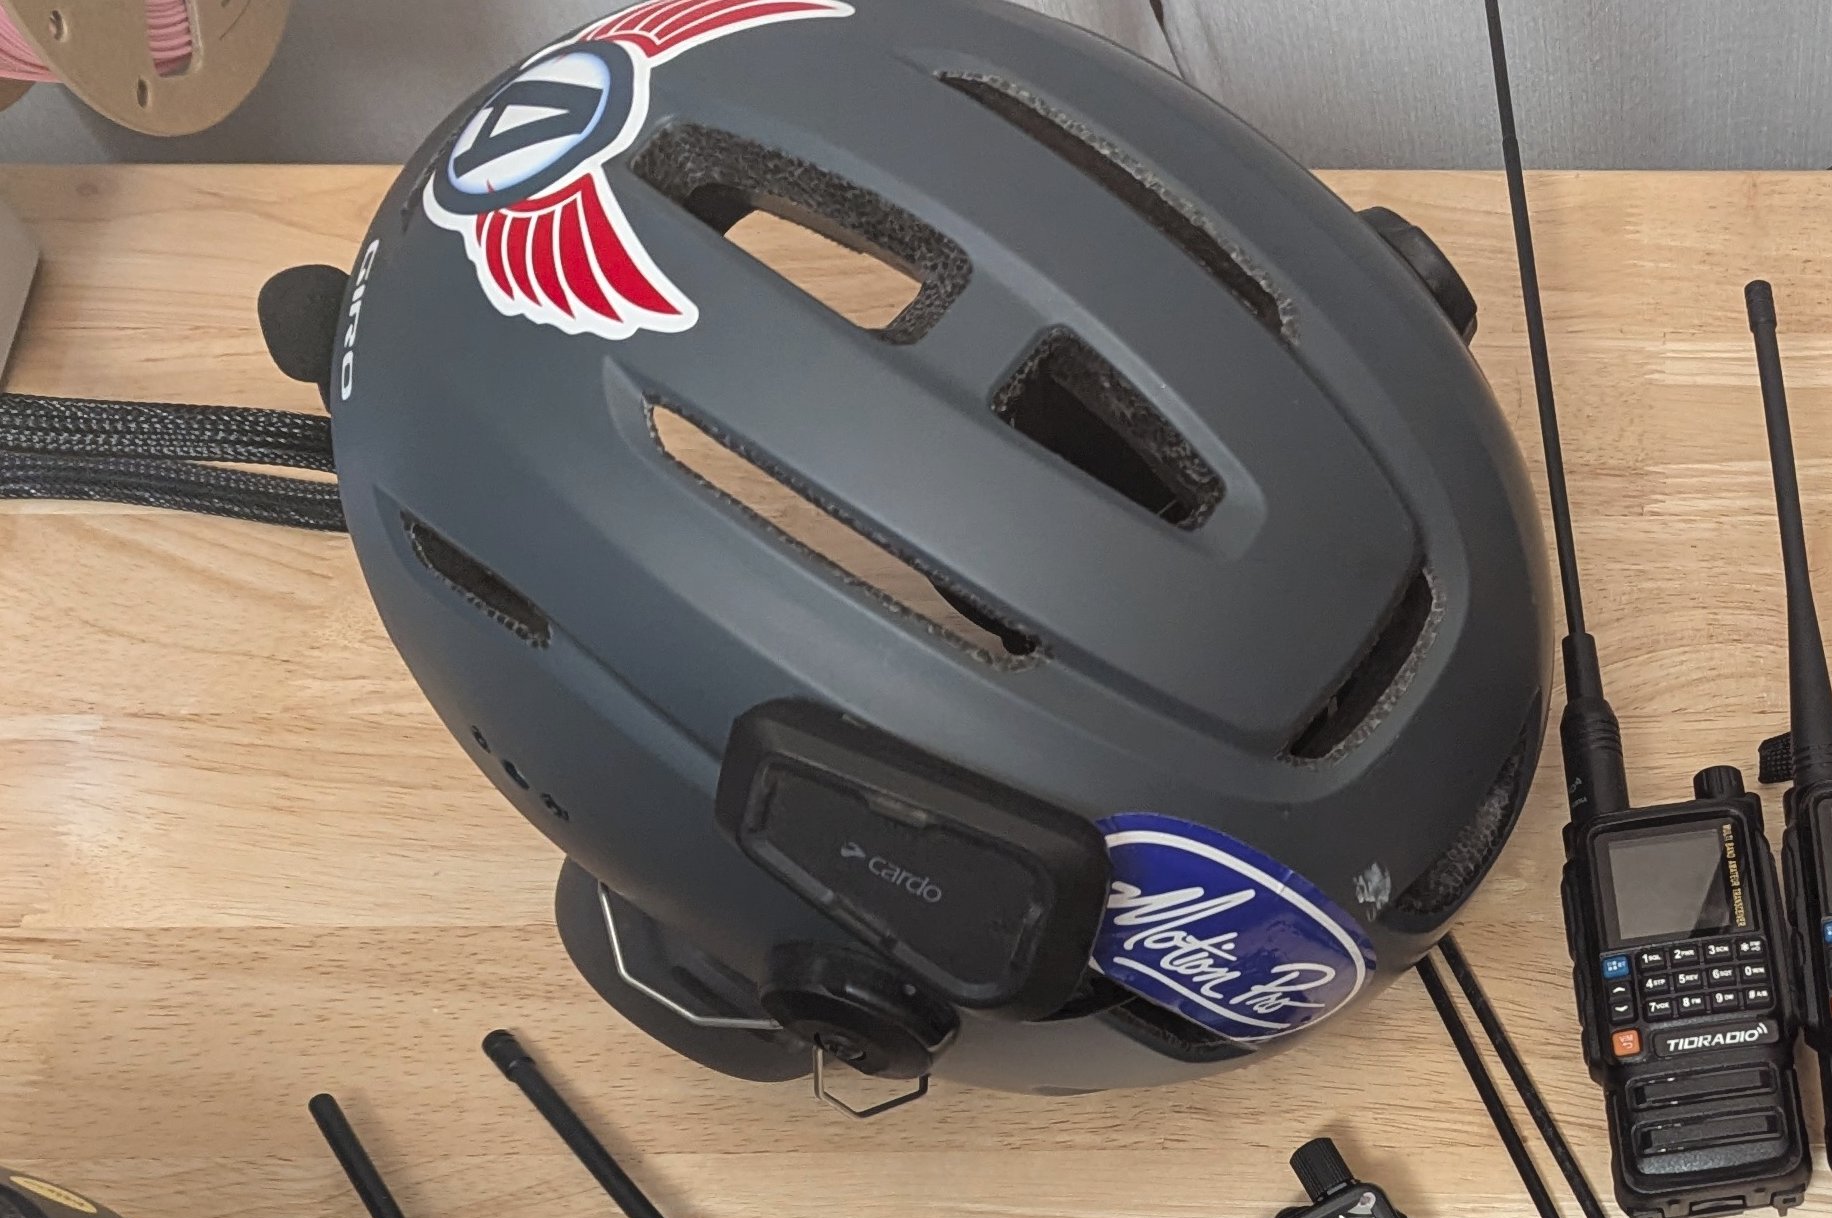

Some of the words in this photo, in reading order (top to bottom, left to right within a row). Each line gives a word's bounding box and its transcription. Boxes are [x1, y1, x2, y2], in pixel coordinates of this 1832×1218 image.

[341, 239, 379, 400] GIRO
[868, 856, 942, 903] cardo
[1667, 1030, 1759, 1051] TIDRADIO
